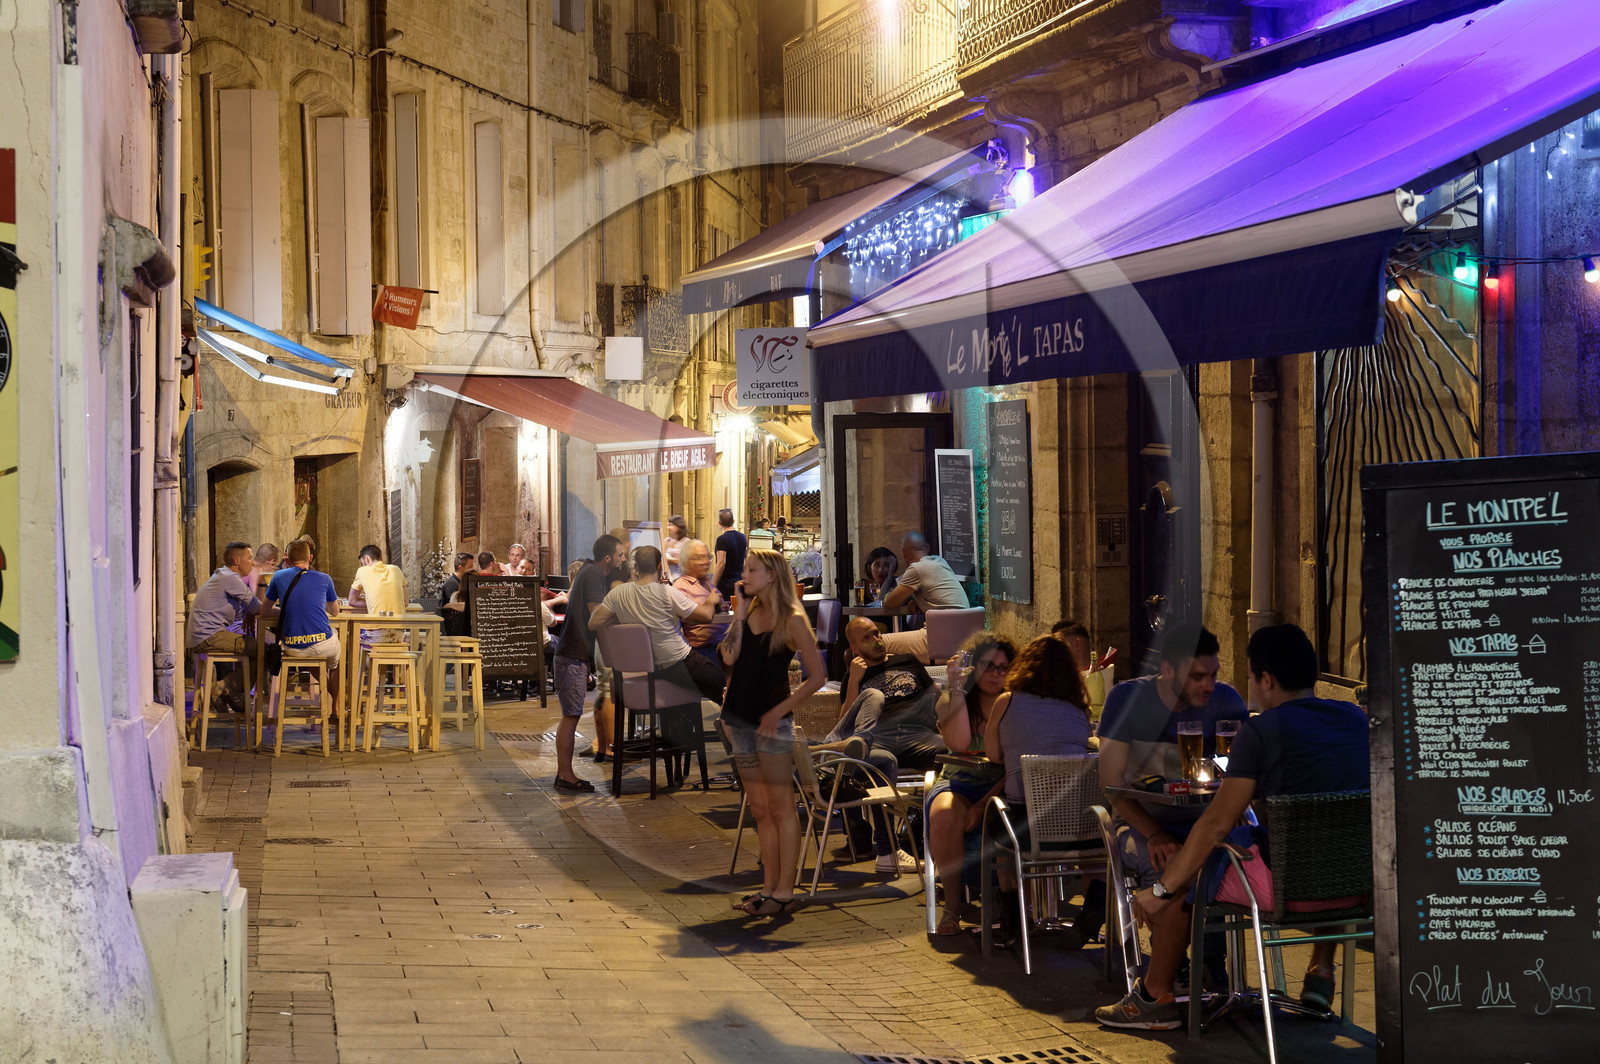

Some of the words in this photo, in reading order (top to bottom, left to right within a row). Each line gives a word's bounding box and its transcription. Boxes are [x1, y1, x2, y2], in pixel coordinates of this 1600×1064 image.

[389, 292, 418, 307] Rumeurs
[947, 327, 967, 375] Le
[1033, 318, 1084, 358] TAPAS
[750, 380, 799, 391] cigarettes
[325, 392, 362, 409] GRAVEUR
[743, 389, 809, 401] électroniques
[610, 453, 656, 476] RESTAURANT
[660, 451, 669, 470] LE
[691, 448, 706, 466] AGILE
[1426, 501, 1457, 527] LE
[1467, 491, 1568, 524] MONTPE'L
[1439, 536, 1464, 547] VOUS
[1469, 532, 1513, 545] PROPOSE
[1453, 551, 1482, 569] NOS
[1487, 547, 1562, 568] PLANCHES
[1398, 577, 1433, 589] PLANCHE
[1434, 578, 1446, 587] DE
[1447, 576, 1495, 587] CHARCUTERIE
[1399, 590, 1434, 601] PLANCHE
[1436, 590, 1448, 600] DE
[1400, 601, 1435, 611] PLANCHE
[1439, 601, 1450, 610] DE
[1452, 600, 1489, 609] FROMAGE
[1401, 611, 1437, 621] PLANCHE
[1401, 621, 1438, 631] PLANCHE
[1441, 621, 1455, 630] DE
[1454, 619, 1482, 629] TAPAS
[285, 632, 326, 645] SUPPORTER
[1448, 637, 1476, 654] NOS
[1475, 633, 1518, 652] TAPAS
[1412, 663, 1454, 673] CALAMARS
[1410, 673, 1451, 681] TARTINE
[1491, 671, 1522, 680] MOZZA
[1412, 681, 1430, 689] DUO
[1494, 678, 1534, 688] TAPENADE
[1516, 687, 1527, 695] DE
[1443, 708, 1454, 716] DE
[1540, 705, 1567, 713] TOMATE
[1419, 742, 1448, 751] MOULES
[1442, 751, 1477, 760] CROQUES
[1438, 760, 1460, 769] CLUB
[1457, 786, 1486, 802] NOS
[1491, 787, 1546, 804] SALADES
[1513, 804, 1523, 813] LE
[1434, 818, 1471, 833] SALADE
[1435, 834, 1473, 846] SALADE
[1477, 835, 1510, 845] POULET
[1512, 835, 1537, 846] SAUCE
[1540, 836, 1568, 846] CAESAR
[1436, 847, 1472, 859] SALADE
[1532, 848, 1560, 858] CHAUD
[1456, 867, 1483, 881] NOS
[1486, 867, 1540, 881] DESSERTS
[1426, 893, 1468, 905] FONDANT
[1471, 896, 1482, 904] AU
[1483, 896, 1525, 905] CHOCOLAT
[1429, 907, 1479, 917] ASSORTIMENT
[1481, 909, 1493, 917] DE
[1429, 918, 1450, 930] CAFÉ
[1455, 920, 1496, 929] MACARONS
[1409, 964, 1462, 1003] Plat
[1482, 970, 1516, 1005] du
[1523, 958, 1592, 1015] Jour
[1121, 1002, 1141, 1019] N
